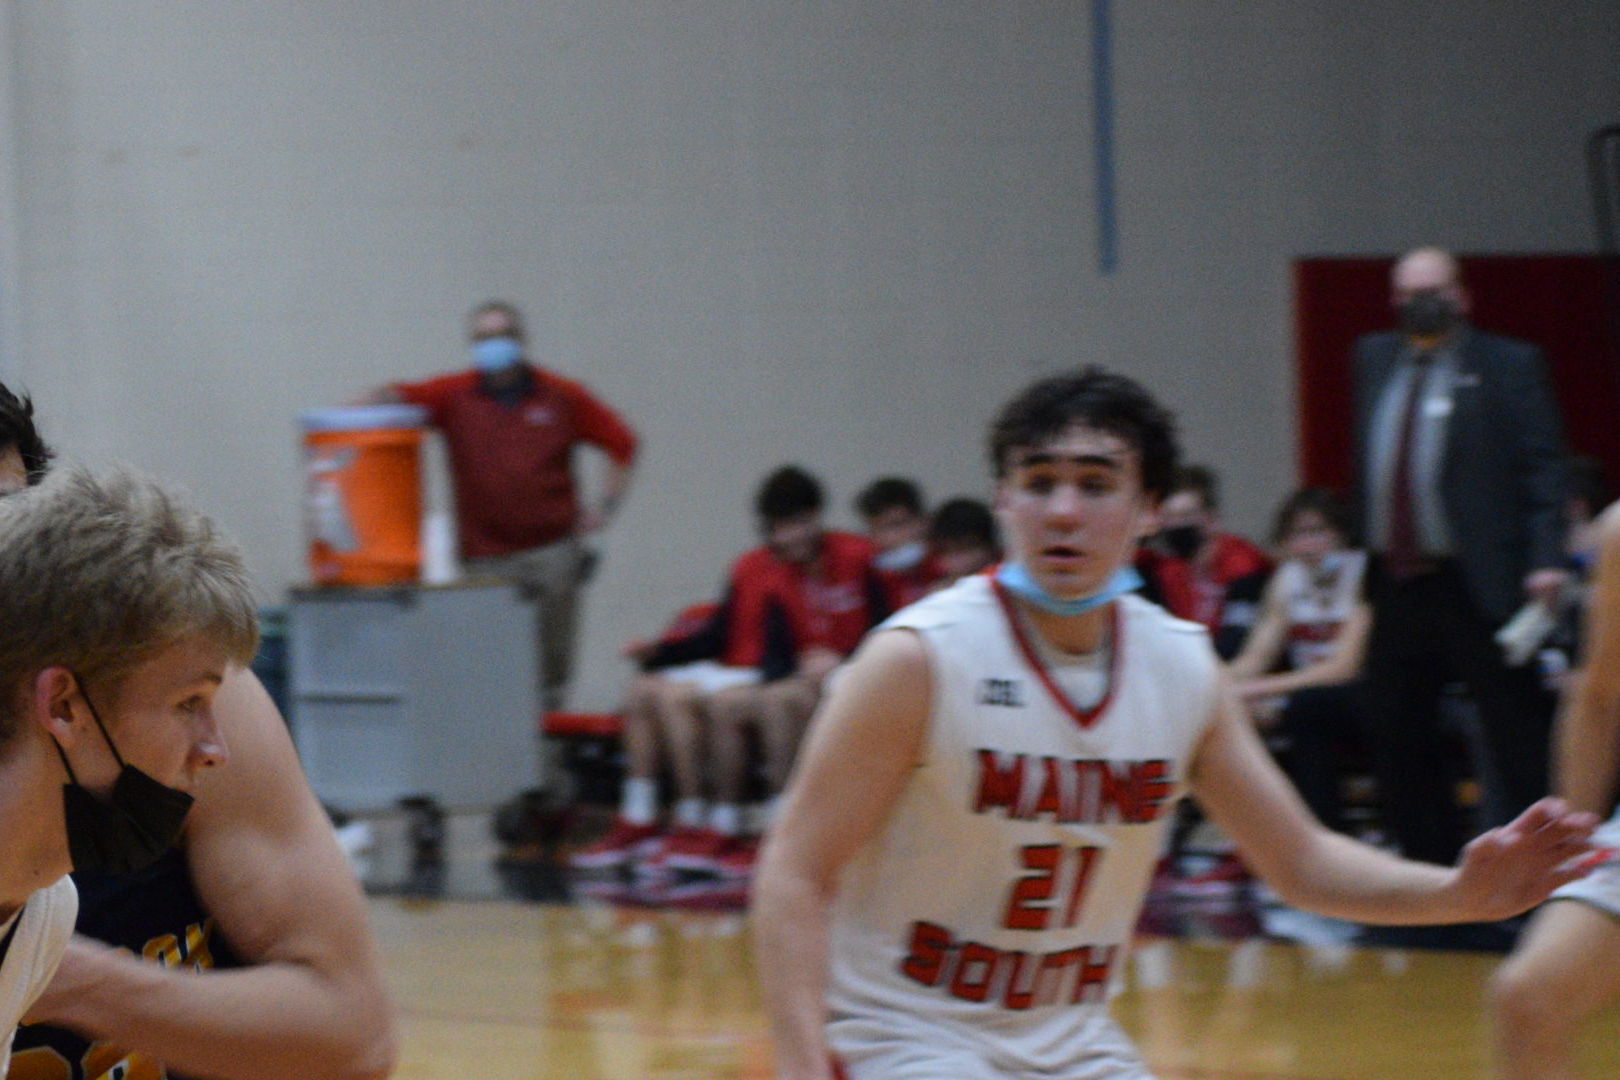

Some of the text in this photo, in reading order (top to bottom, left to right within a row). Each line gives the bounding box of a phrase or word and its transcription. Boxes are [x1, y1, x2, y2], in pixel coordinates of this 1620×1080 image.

[973, 748, 1176, 823] MAINE
[997, 843, 1103, 930] 21
[899, 920, 1120, 1010] SOUTH
